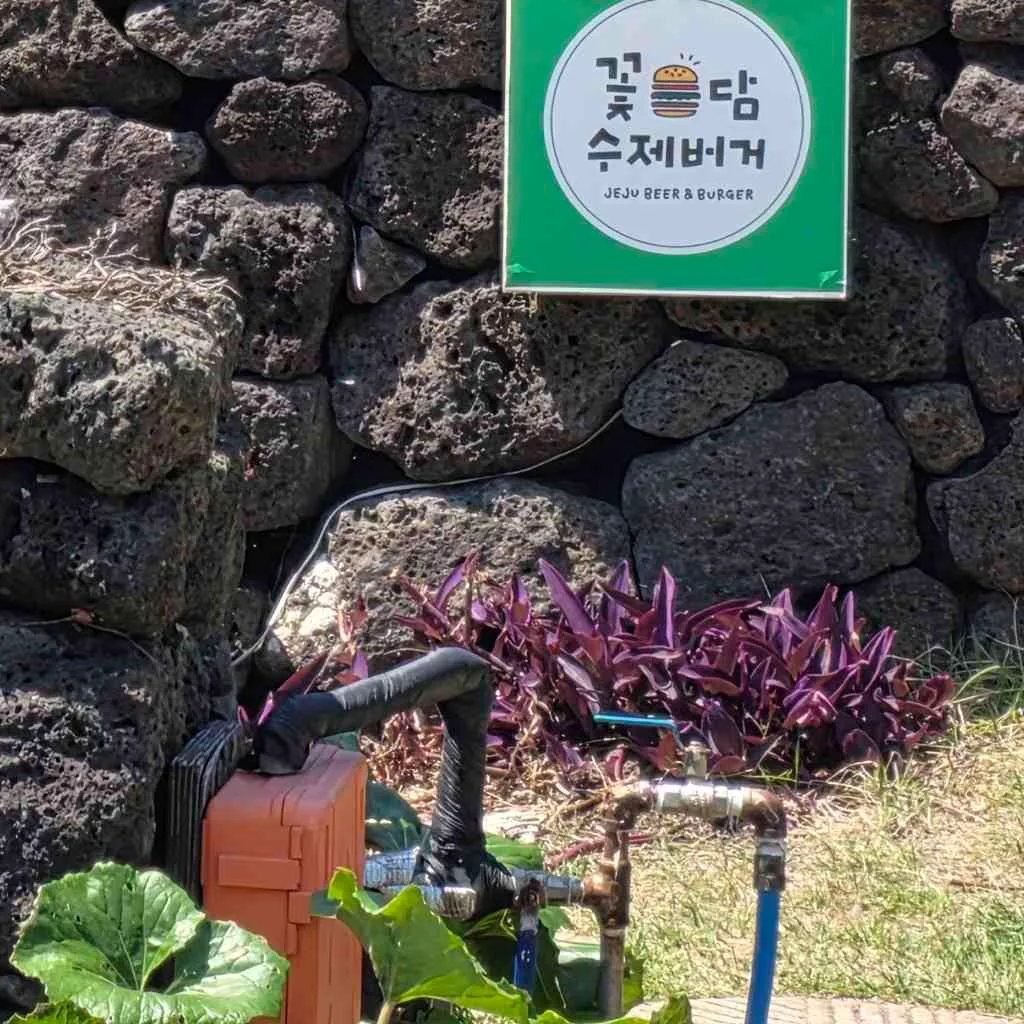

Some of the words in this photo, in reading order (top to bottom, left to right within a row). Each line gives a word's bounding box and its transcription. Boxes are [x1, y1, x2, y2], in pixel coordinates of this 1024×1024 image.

[587, 127, 766, 173] 수제버거
[603, 187, 640, 200] JEJU
[643, 187, 680, 200] BEER
[684, 188, 694, 200] &
[697, 188, 754, 201] BURGER
